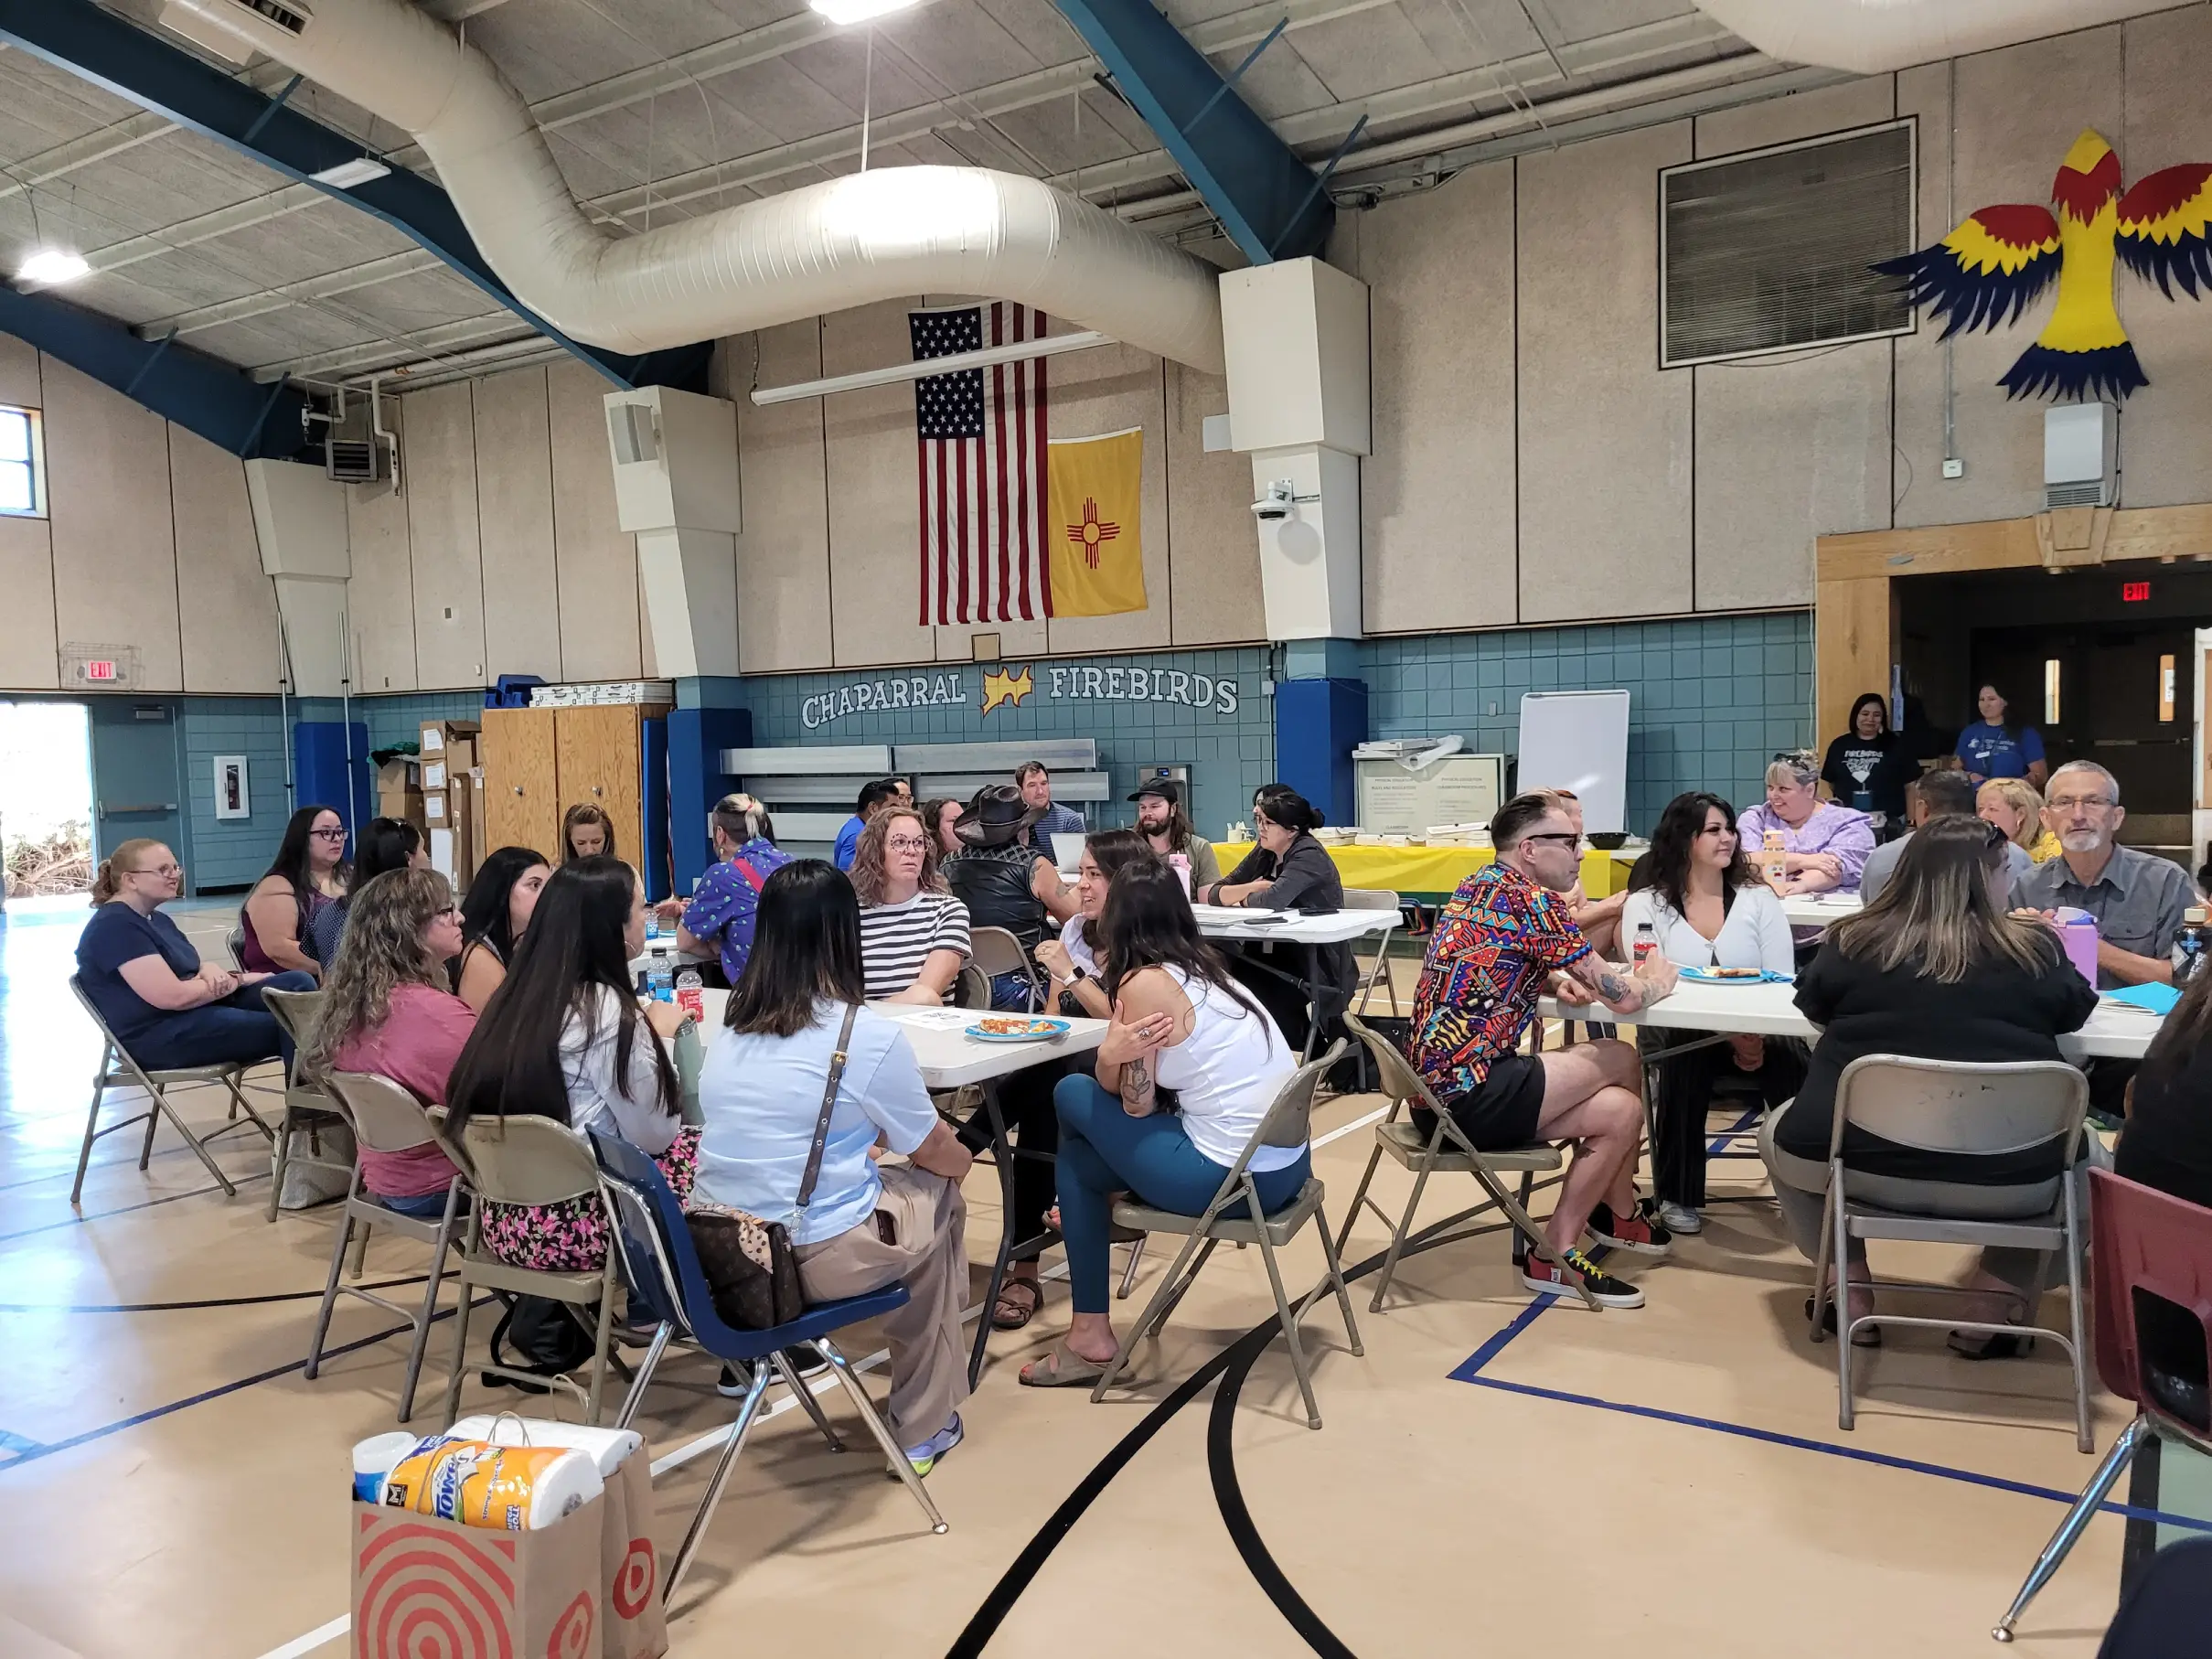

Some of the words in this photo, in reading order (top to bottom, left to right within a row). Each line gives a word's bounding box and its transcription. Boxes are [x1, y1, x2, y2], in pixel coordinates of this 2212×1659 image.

[2123, 582, 2150, 601] EXIT
[90, 661, 112, 678] EXIT
[801, 672, 967, 730] CHAPARRAL
[1048, 667, 1239, 714] FIREBIRDS
[482, 1494, 492, 1520] Strong
